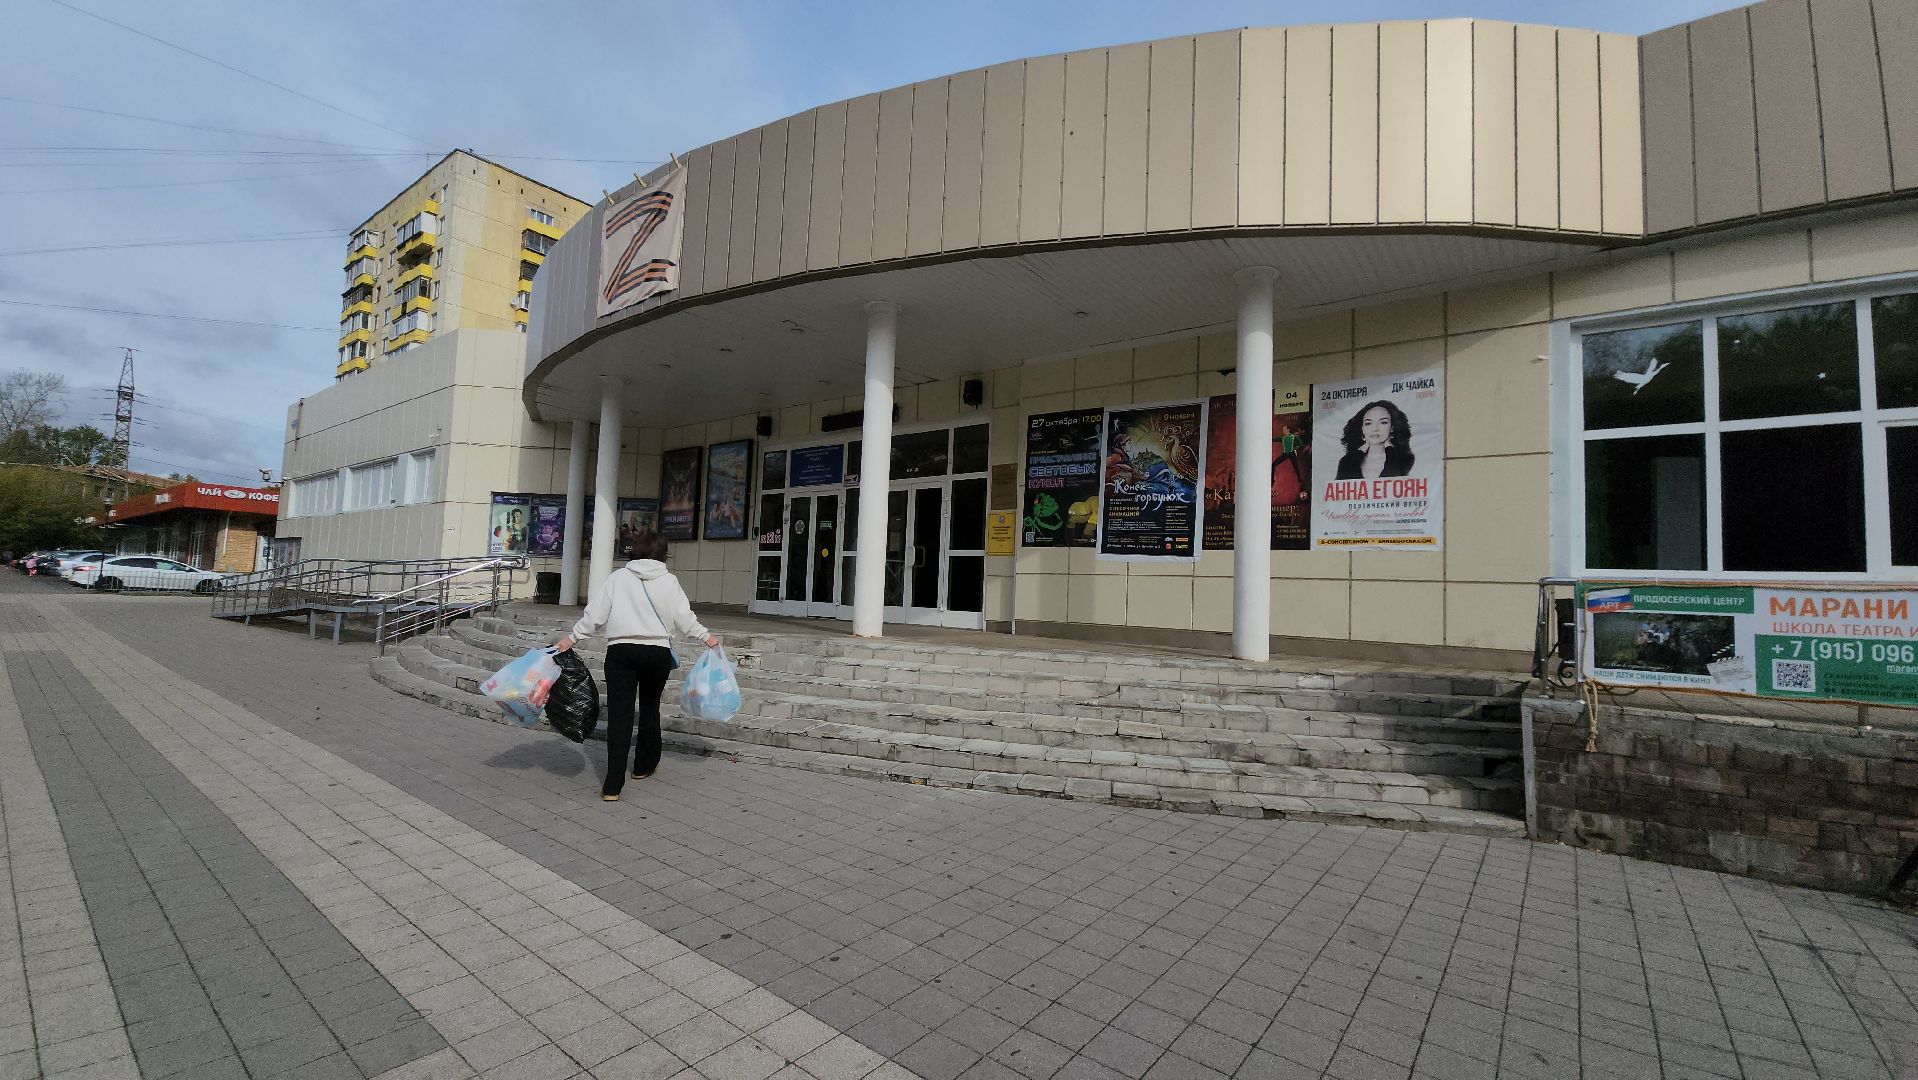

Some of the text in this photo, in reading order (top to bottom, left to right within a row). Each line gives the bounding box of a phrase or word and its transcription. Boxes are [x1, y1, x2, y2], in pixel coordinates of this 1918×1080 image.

[1391, 378, 1435, 393] ДК ЧАЙКА
[1321, 387, 1368, 400] 24 ОКТЯБРЯ
[1031, 418, 1045, 428] 27
[1029, 463, 1097, 478] СВЕТОВЫХ
[197, 487, 279, 502] ЧАЙ КОФЕ
[1205, 488, 1235, 501] «Ка
[1325, 478, 1428, 502] АННА ЕГОЯН
[1348, 502, 1401, 510] ПОЭТИЧЕСКИЙ
[1599, 601, 1620, 609] АРТ
[1633, 594, 1745, 606] ПРОДЮСЕРСКИЙ ЦЕНТР
[1770, 596, 1908, 621] МАРАНИ
[1772, 621, 1836, 634] ШКОЛА
[1842, 624, 1904, 637] ТЕАТРА
[1810, 638, 1864, 663] (915)
[1871, 643, 1915, 664] 096
[1886, 664, 1918, 674] maran
[1594, 670, 1711, 684] НАШИ ДЕТИ СНИМАЮТСЯ В КИНО
